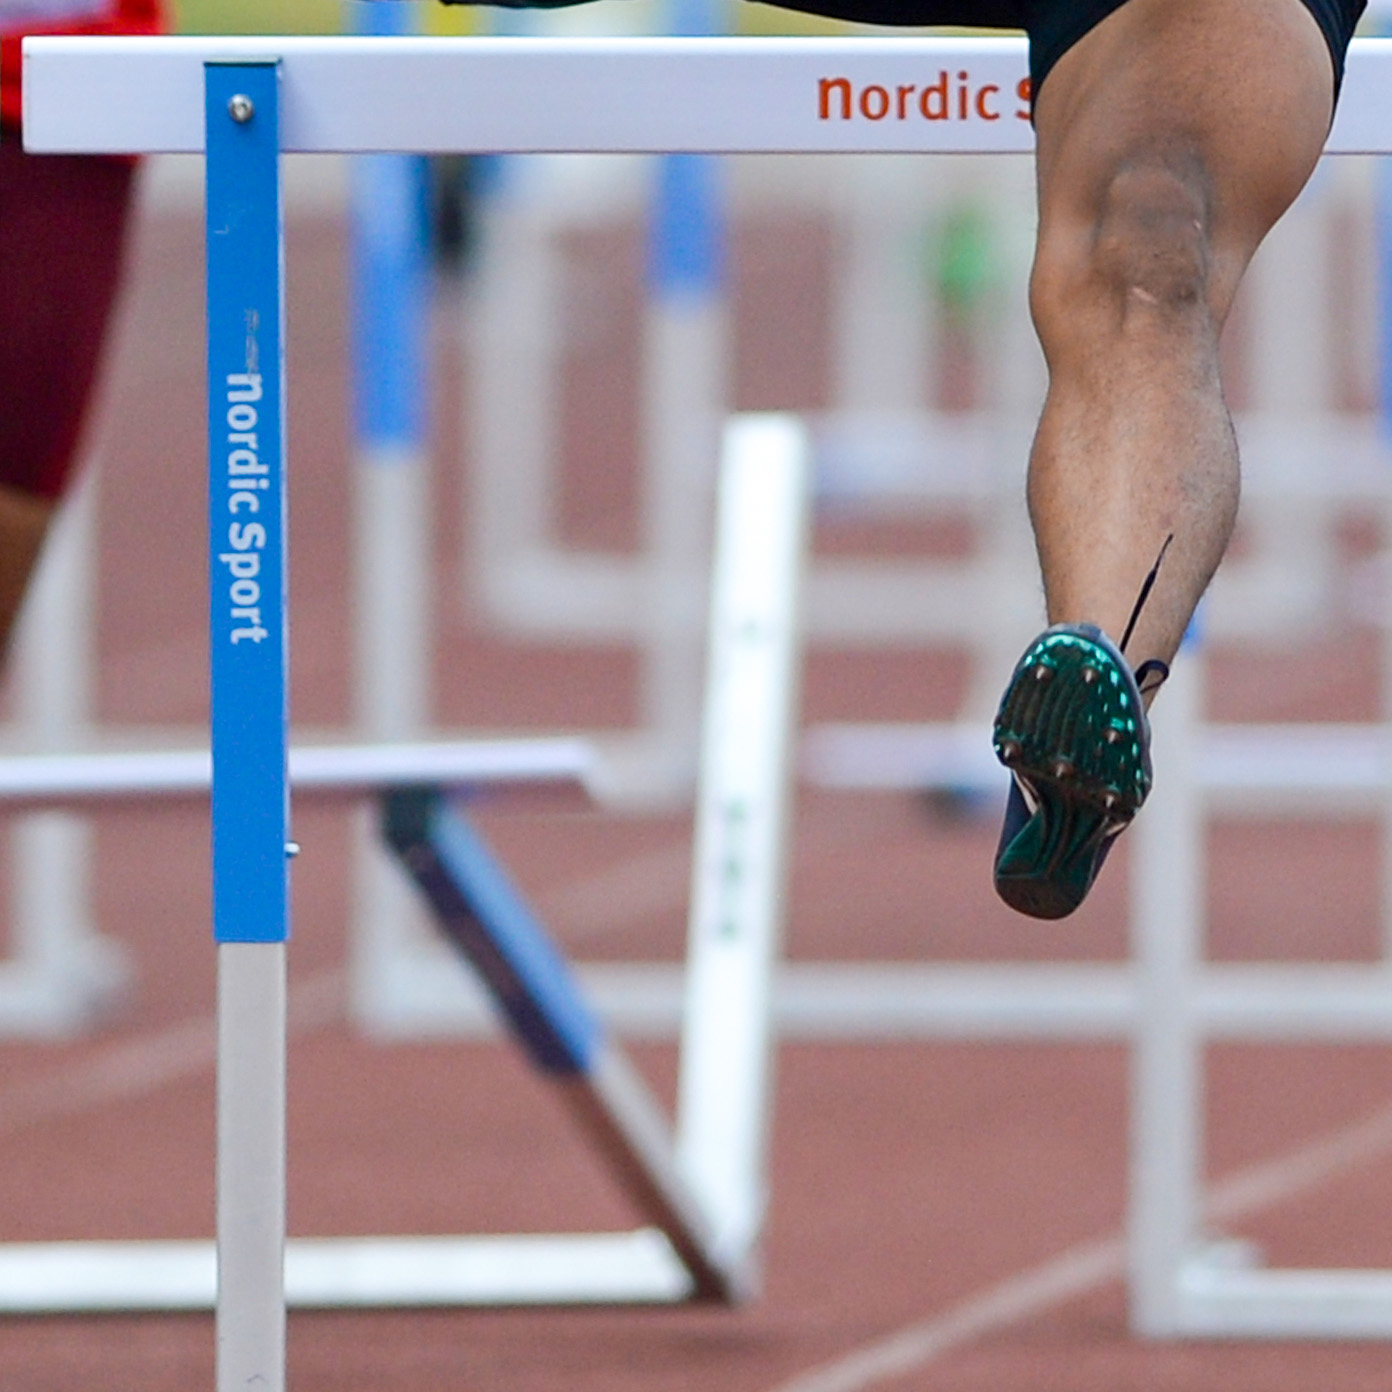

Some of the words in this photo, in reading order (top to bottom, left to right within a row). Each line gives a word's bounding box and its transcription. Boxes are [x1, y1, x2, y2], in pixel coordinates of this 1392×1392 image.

[817, 70, 1001, 121] nordic
[228, 375, 268, 513] nordic
[221, 523, 267, 643] Sport
